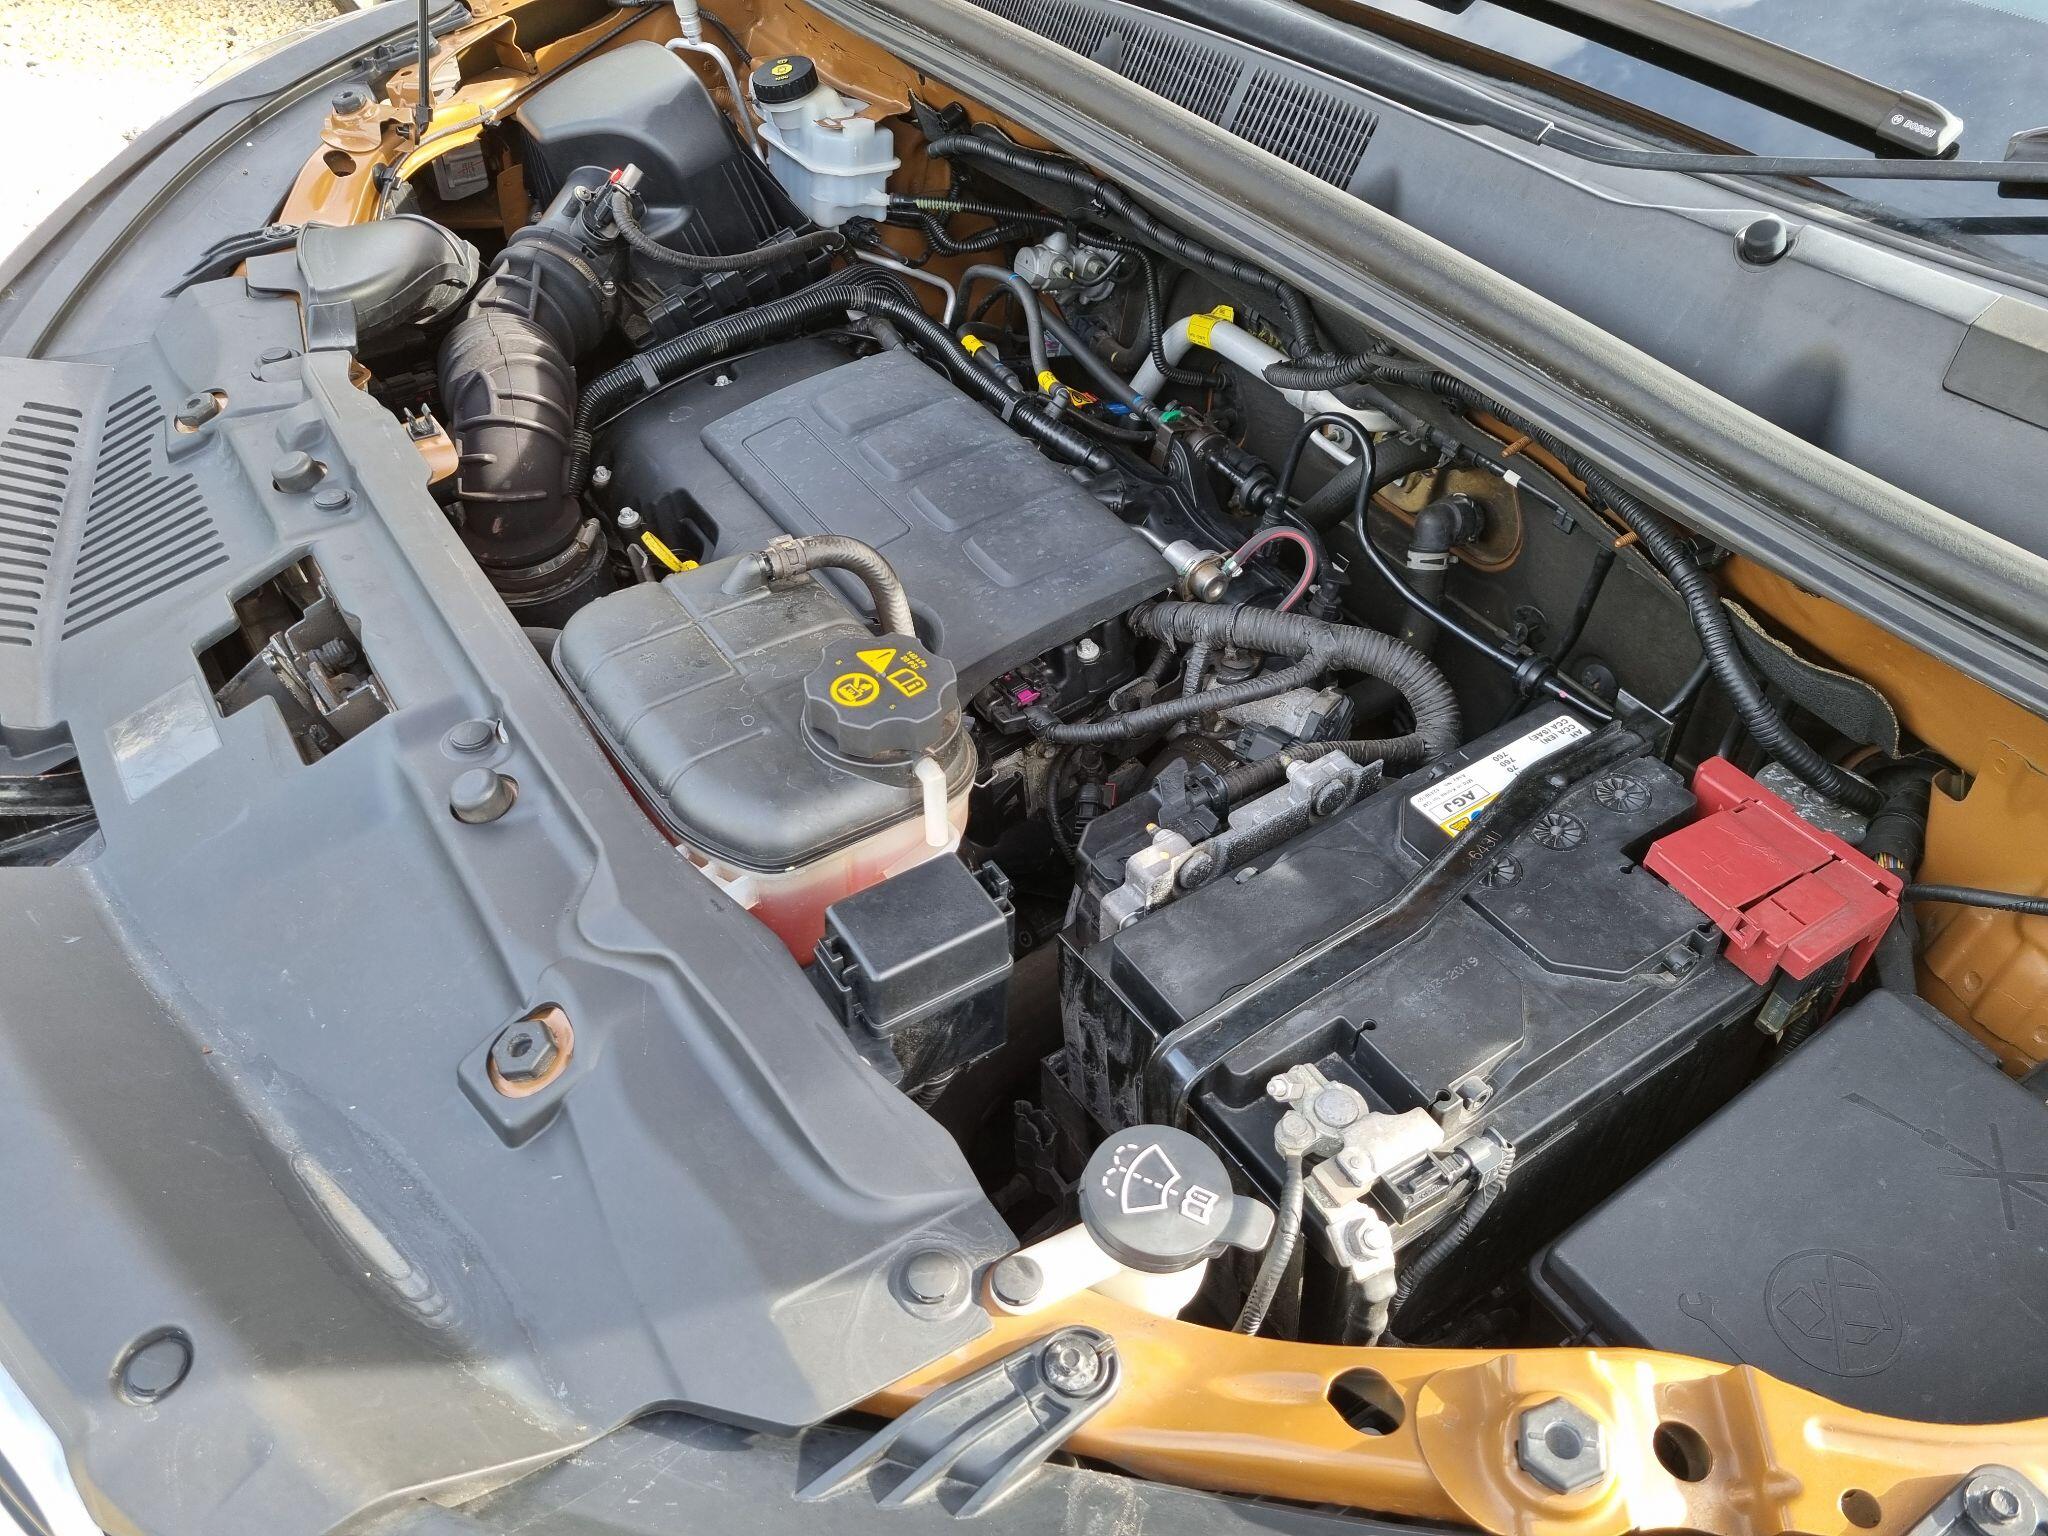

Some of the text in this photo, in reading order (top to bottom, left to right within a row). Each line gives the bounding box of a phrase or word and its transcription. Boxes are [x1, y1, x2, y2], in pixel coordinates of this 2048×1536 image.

[1902, 119, 1937, 138] BOSCH
[1528, 726, 1552, 742] (SAE)
[1550, 718, 1569, 730] CCA
[1499, 724, 1576, 768] CCA (EN) 760
[1506, 728, 1583, 773] AH 70
[1443, 790, 1476, 813] AGJ
